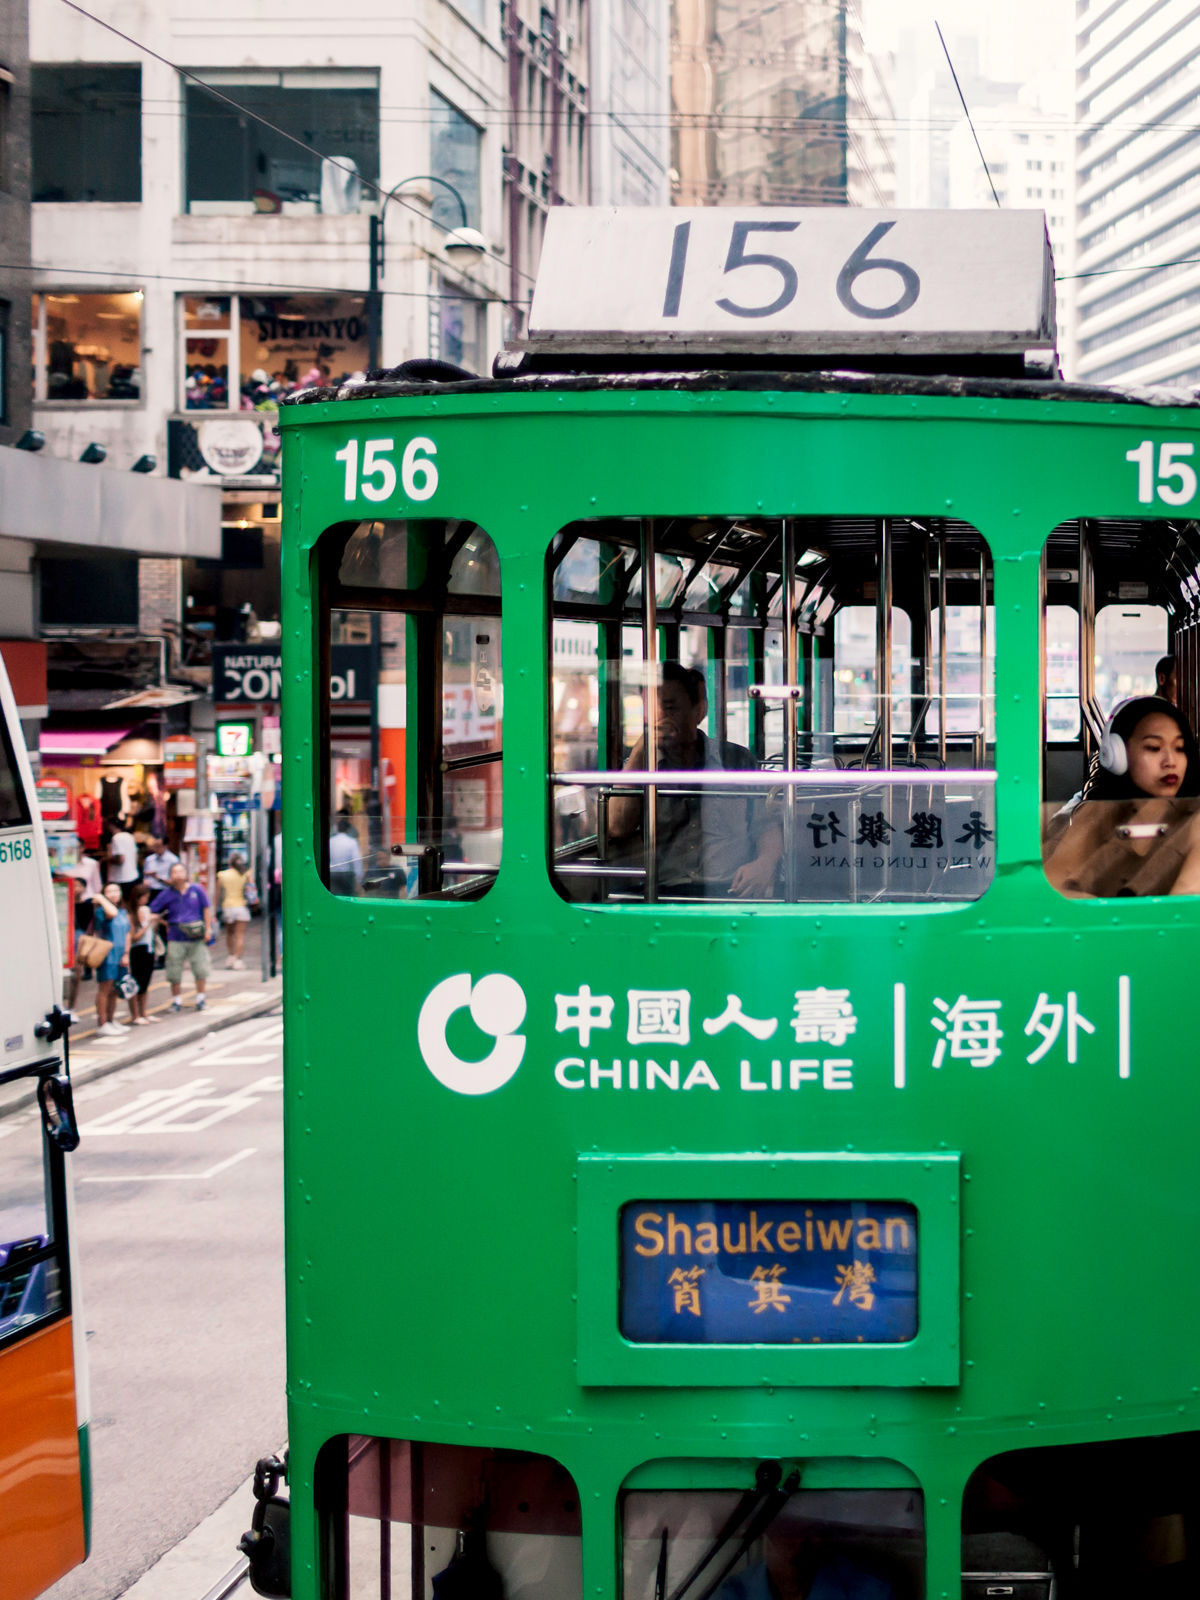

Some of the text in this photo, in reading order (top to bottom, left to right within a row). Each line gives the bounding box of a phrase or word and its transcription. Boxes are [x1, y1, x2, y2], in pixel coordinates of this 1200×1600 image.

[663, 221, 921, 320] 156
[335, 436, 439, 503] 156
[224, 655, 282, 669] NATURA
[0, 838, 32, 864] 6168
[554, 984, 858, 1047] 中國人壽
[930, 991, 1095, 1069] 海外
[554, 1058, 854, 1091] CHINA LIFE
[635, 1209, 908, 1257] Shaukeiwan
[668, 1260, 876, 1317] 筲箕灣
